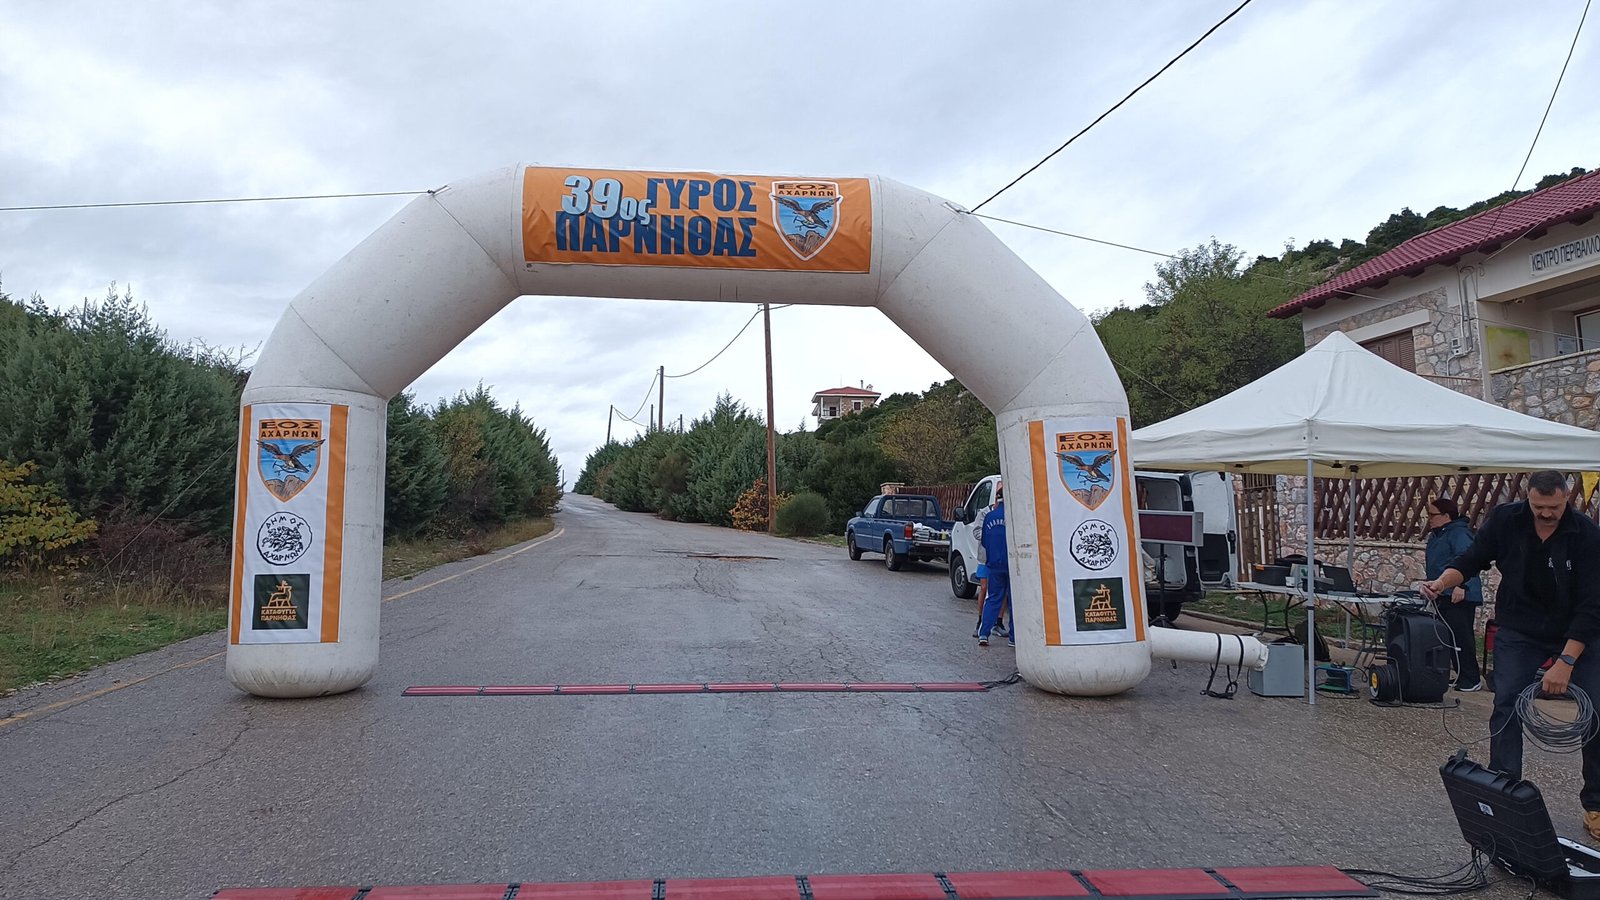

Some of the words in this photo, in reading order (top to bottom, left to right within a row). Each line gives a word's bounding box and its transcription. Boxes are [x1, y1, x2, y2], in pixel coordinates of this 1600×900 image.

[647, 178, 757, 212] ΓΥΡΟΣ
[555, 211, 757, 257] ΠΑΡΝΗΘΑΣ
[1532, 248, 1560, 271] ΚΕΝΤΡΟ
[261, 430, 319, 438] ΑΧΑΡΝΩΝ
[1060, 442, 1112, 451] ΑΧΑΡΝΩΝ
[266, 515, 305, 529] ΔΗΜΟΣ
[1077, 523, 1113, 537] ΔΗΜΟΣ
